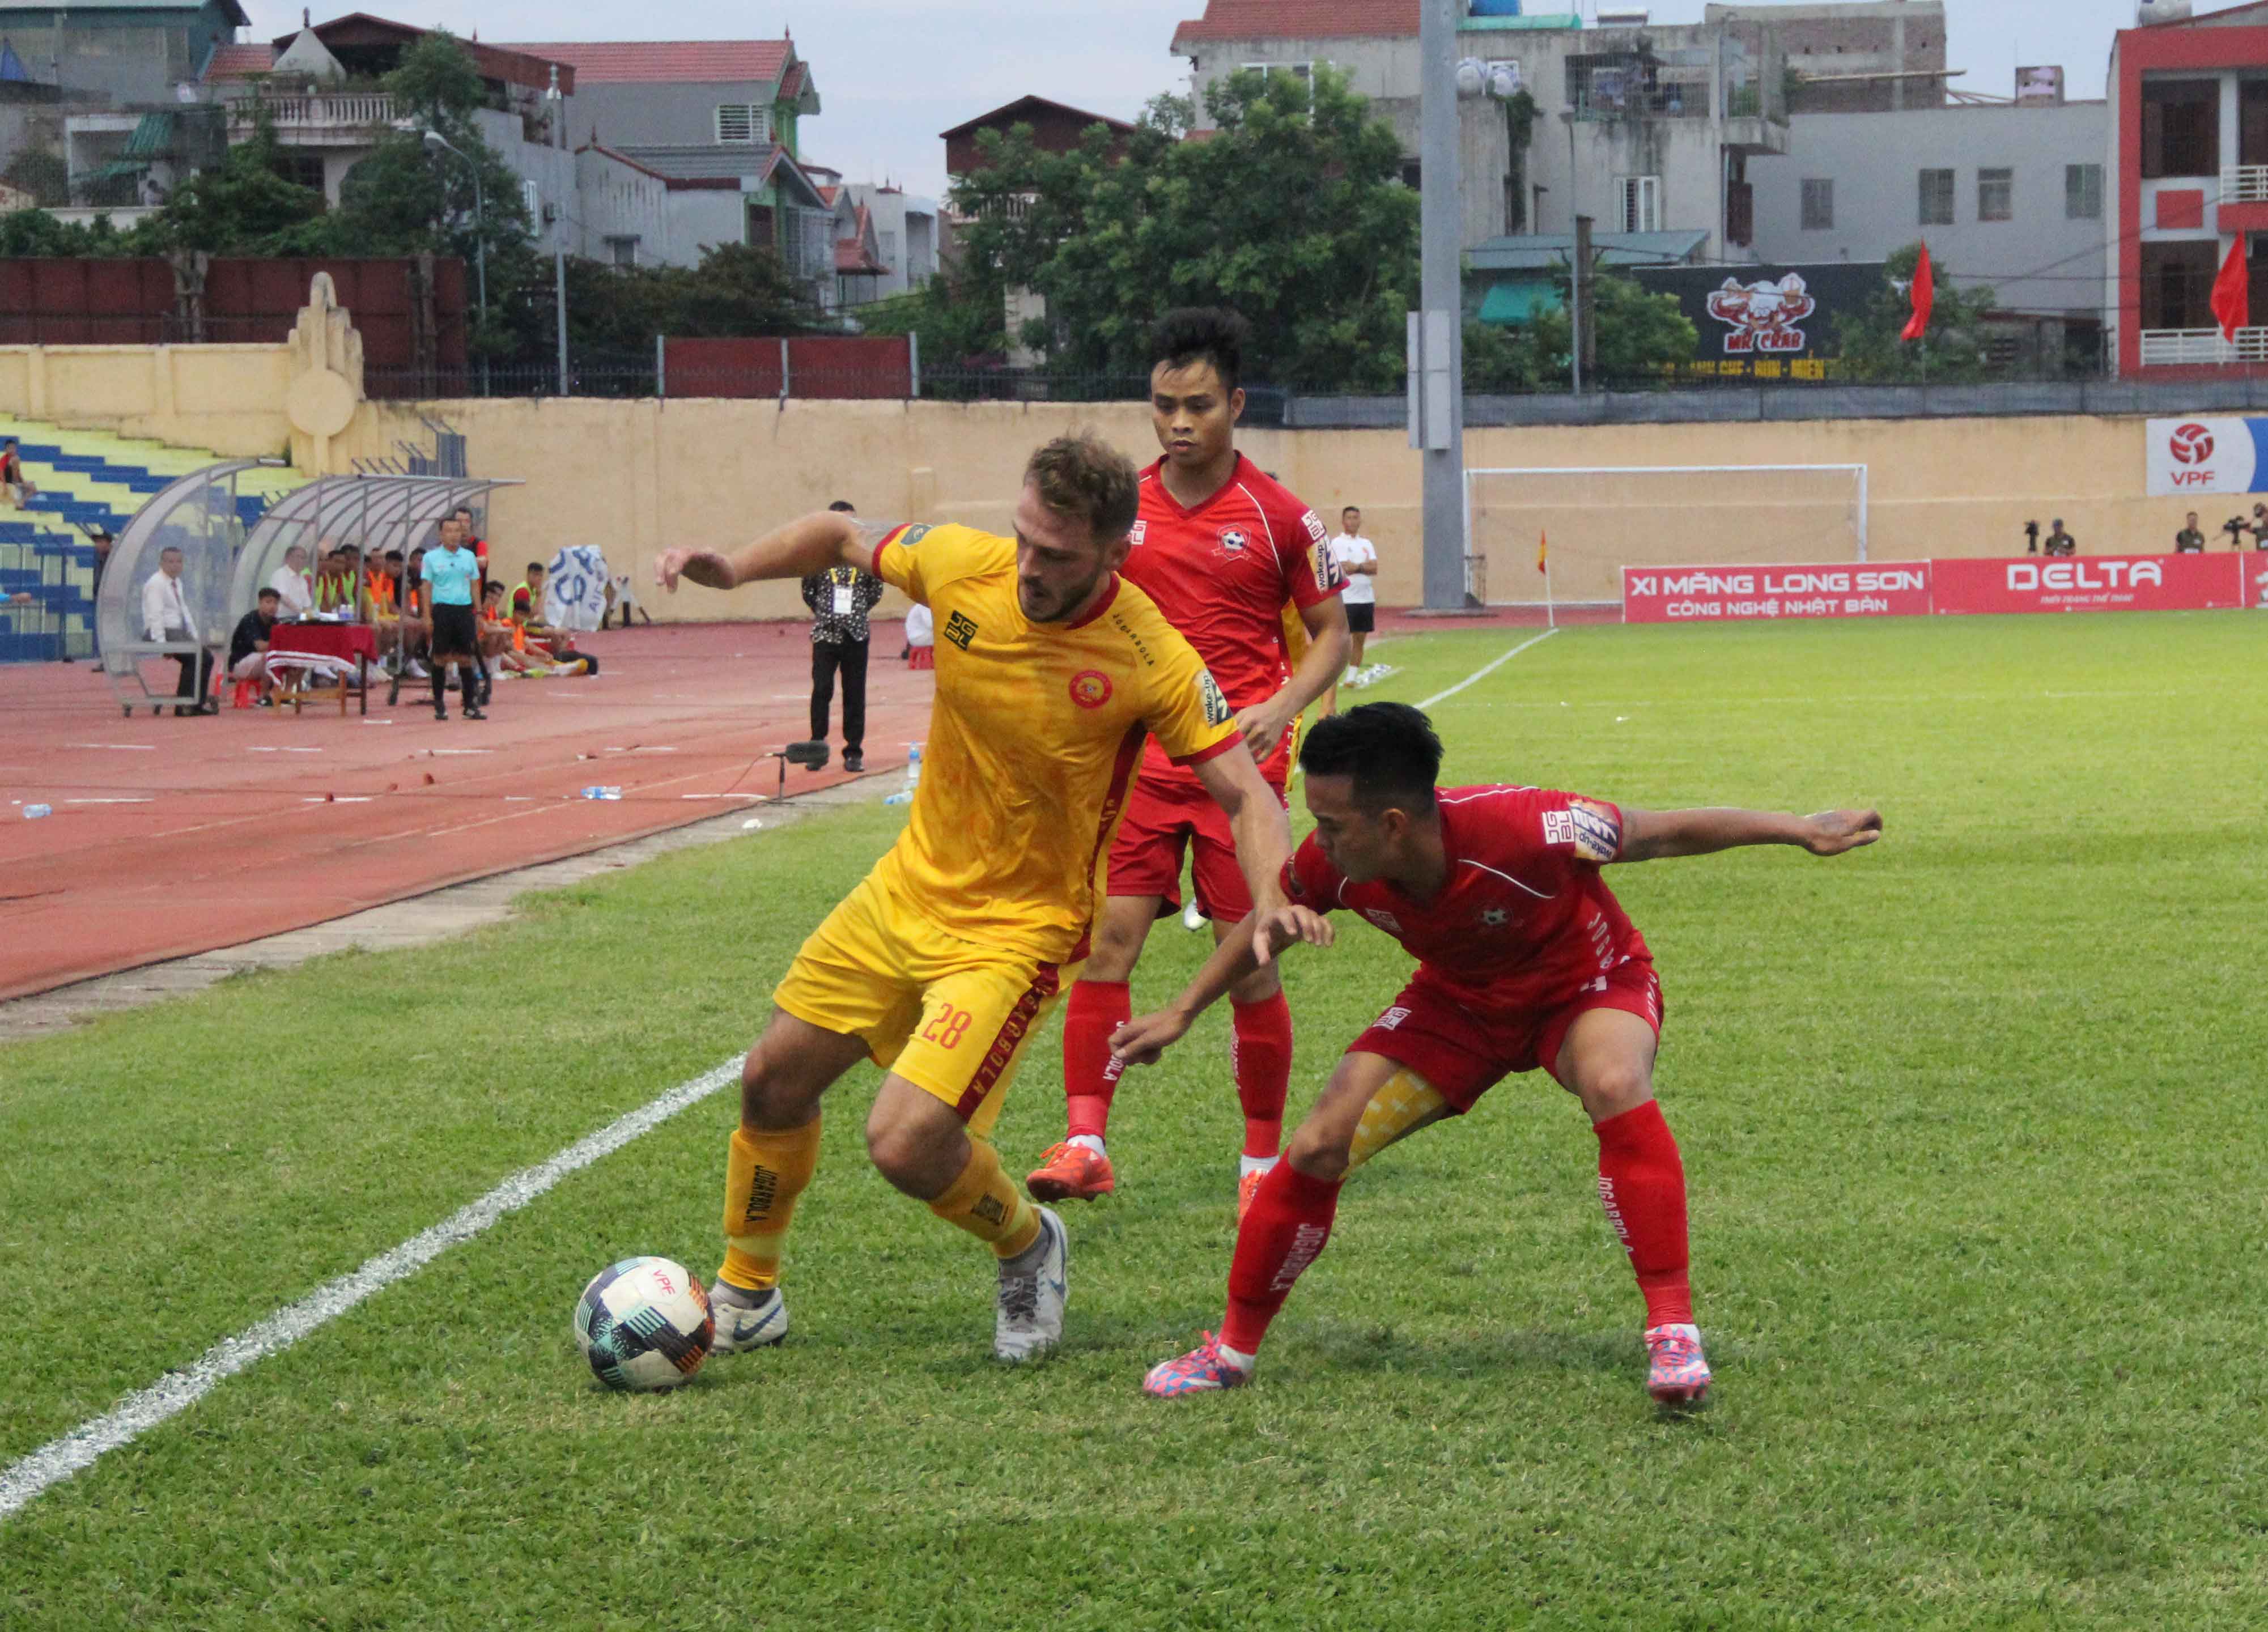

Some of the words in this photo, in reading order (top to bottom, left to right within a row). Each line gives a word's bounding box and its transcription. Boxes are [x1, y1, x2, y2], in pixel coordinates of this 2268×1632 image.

[2169, 471, 2215, 486] VPF
[1316, 545, 1325, 588] wake-up
[2007, 560, 2161, 590] DELTA
[1632, 575, 1657, 596] XI
[1663, 571, 1753, 595] MĂNG
[1764, 572, 1850, 593] LONG
[1856, 570, 1924, 591] SƠN
[1666, 600, 1721, 616] CÔNG
[1727, 598, 1779, 617] NGHỆ
[1785, 597, 1839, 615] NHẬT
[1203, 675, 1214, 722] wake-up
[1579, 831, 1612, 860] wake-up
[921, 1002, 972, 1050] 28
[653, 1269, 676, 1295] VPF
